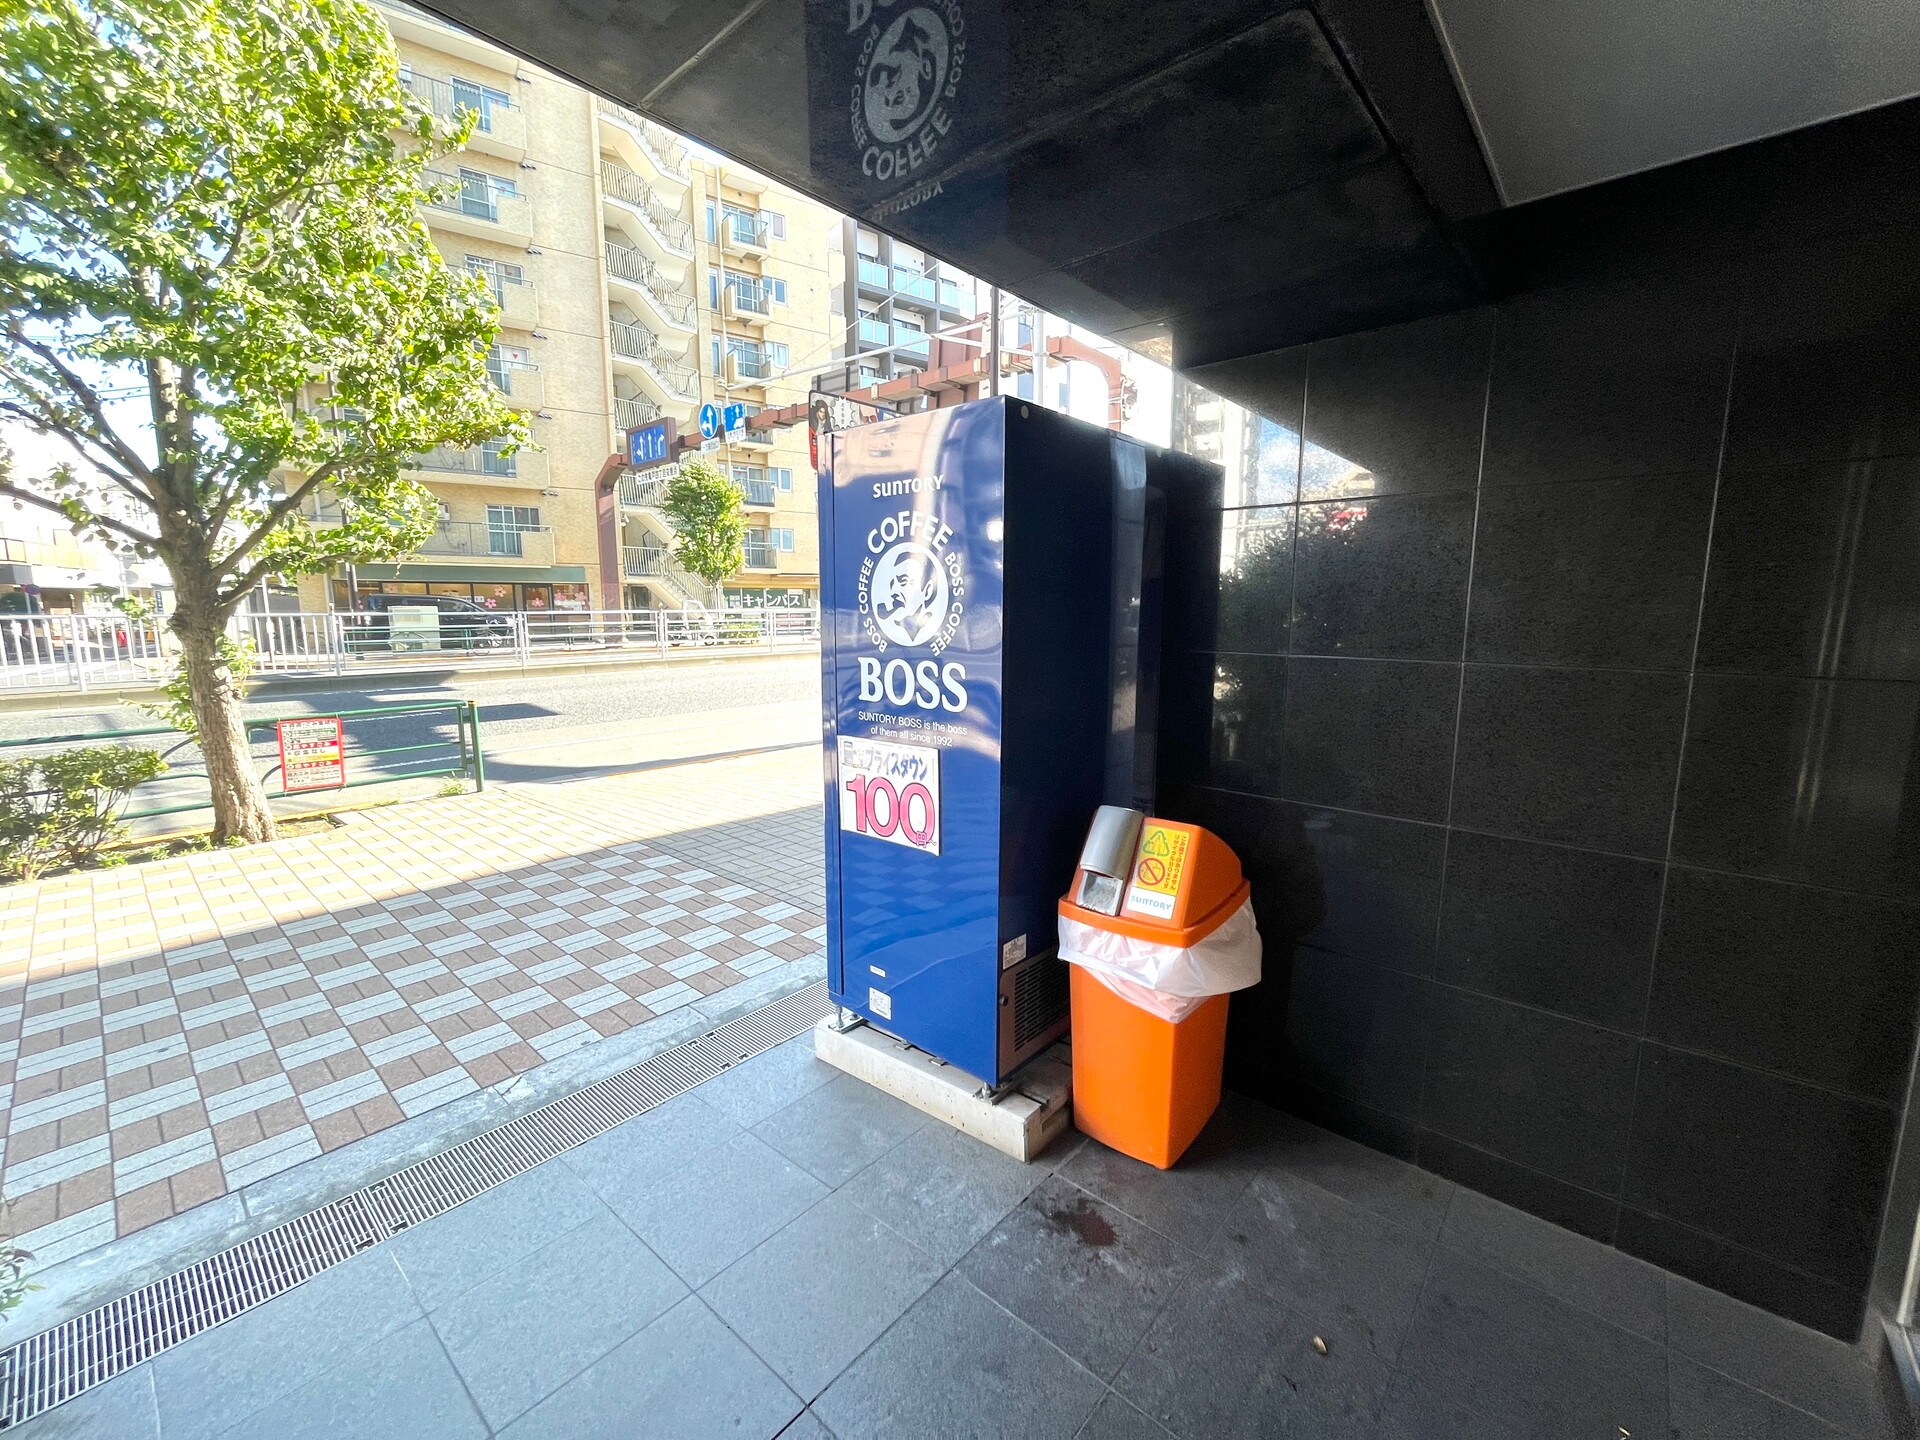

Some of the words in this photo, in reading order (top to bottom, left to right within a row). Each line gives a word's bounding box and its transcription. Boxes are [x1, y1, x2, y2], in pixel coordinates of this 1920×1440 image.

[872, 475, 944, 498] SUNTORY
[867, 510, 954, 554] COFFEE
[858, 556, 874, 615] COFFEE
[944, 552, 965, 597] BOSS
[863, 617, 888, 653] BOSS
[929, 602, 963, 657] COFFEE
[857, 656, 968, 713] BOSS
[858, 711, 897, 725] SUNTORY
[898, 716, 922, 729] BOSS
[923, 719, 931, 730] is
[932, 722, 946, 732] the
[947, 723, 968, 735] boss
[870, 726, 878, 735] of
[879, 727, 898, 738] them
[899, 730, 909, 740] all
[910, 732, 931, 743] since
[933, 735, 953, 747] 1992
[1131, 895, 1172, 910] SUNTORY
